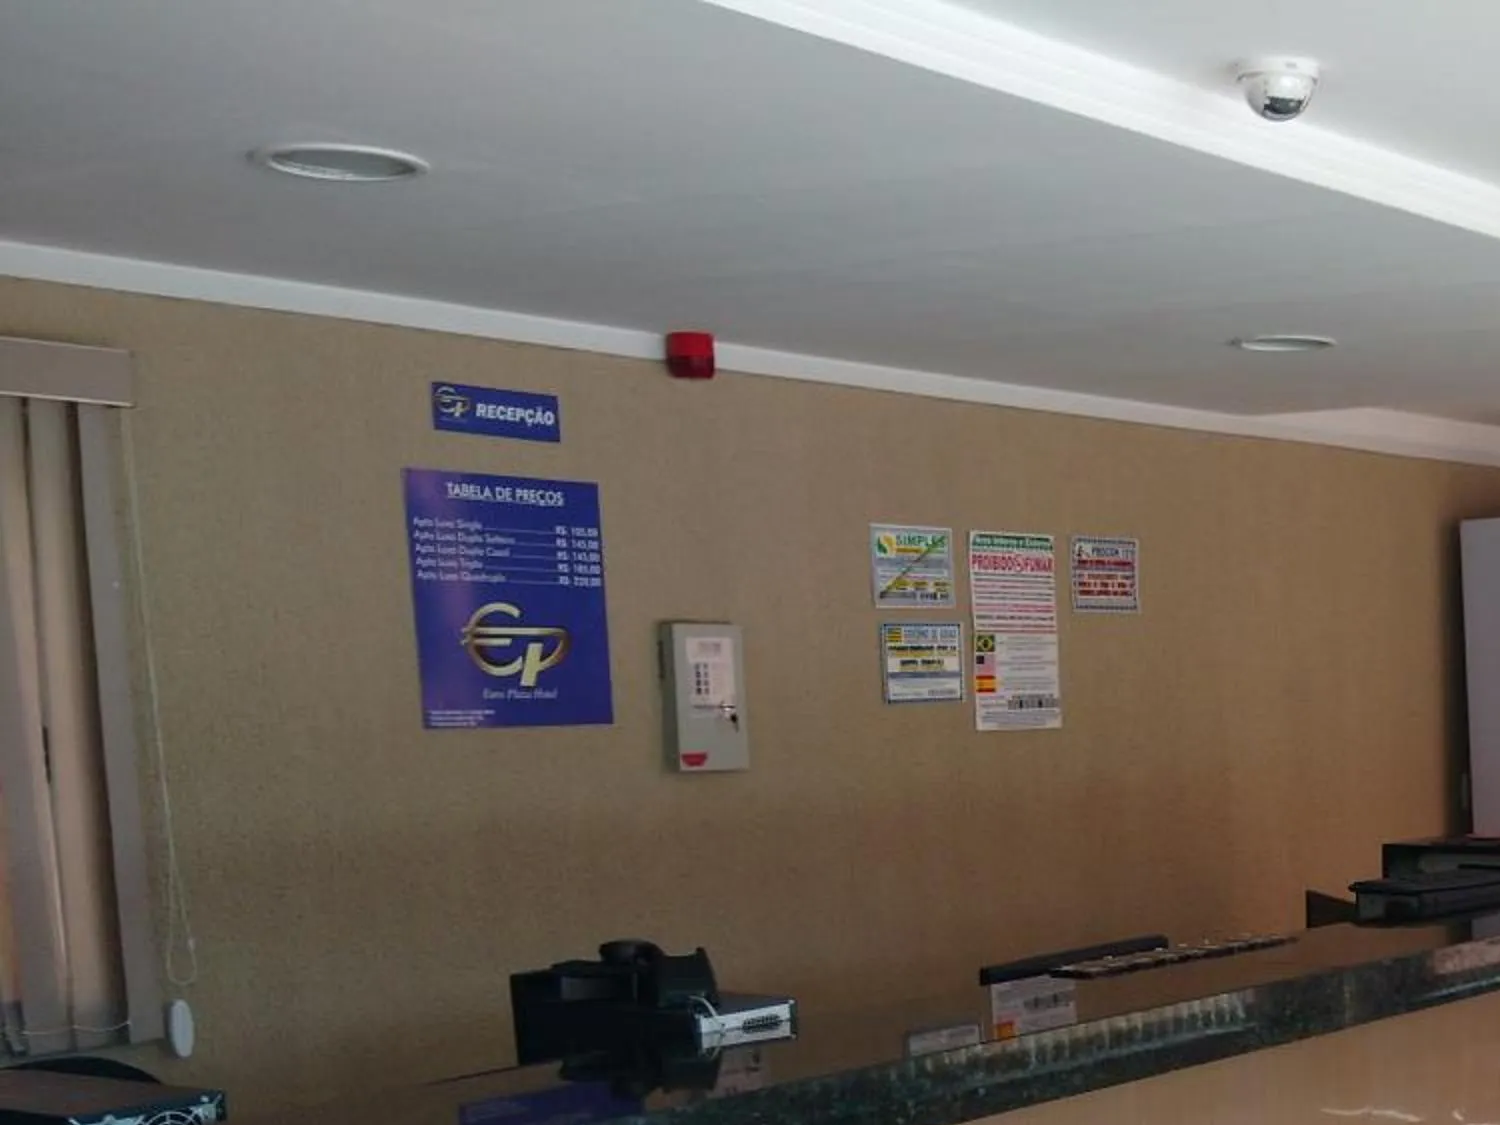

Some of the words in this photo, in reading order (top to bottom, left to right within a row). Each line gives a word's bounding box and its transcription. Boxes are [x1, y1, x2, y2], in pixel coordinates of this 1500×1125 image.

[475, 403, 556, 426] RECEPÇÃO
[446, 482, 493, 500] TABELA
[495, 487, 514, 502] DE
[515, 489, 565, 506] PREÇOS
